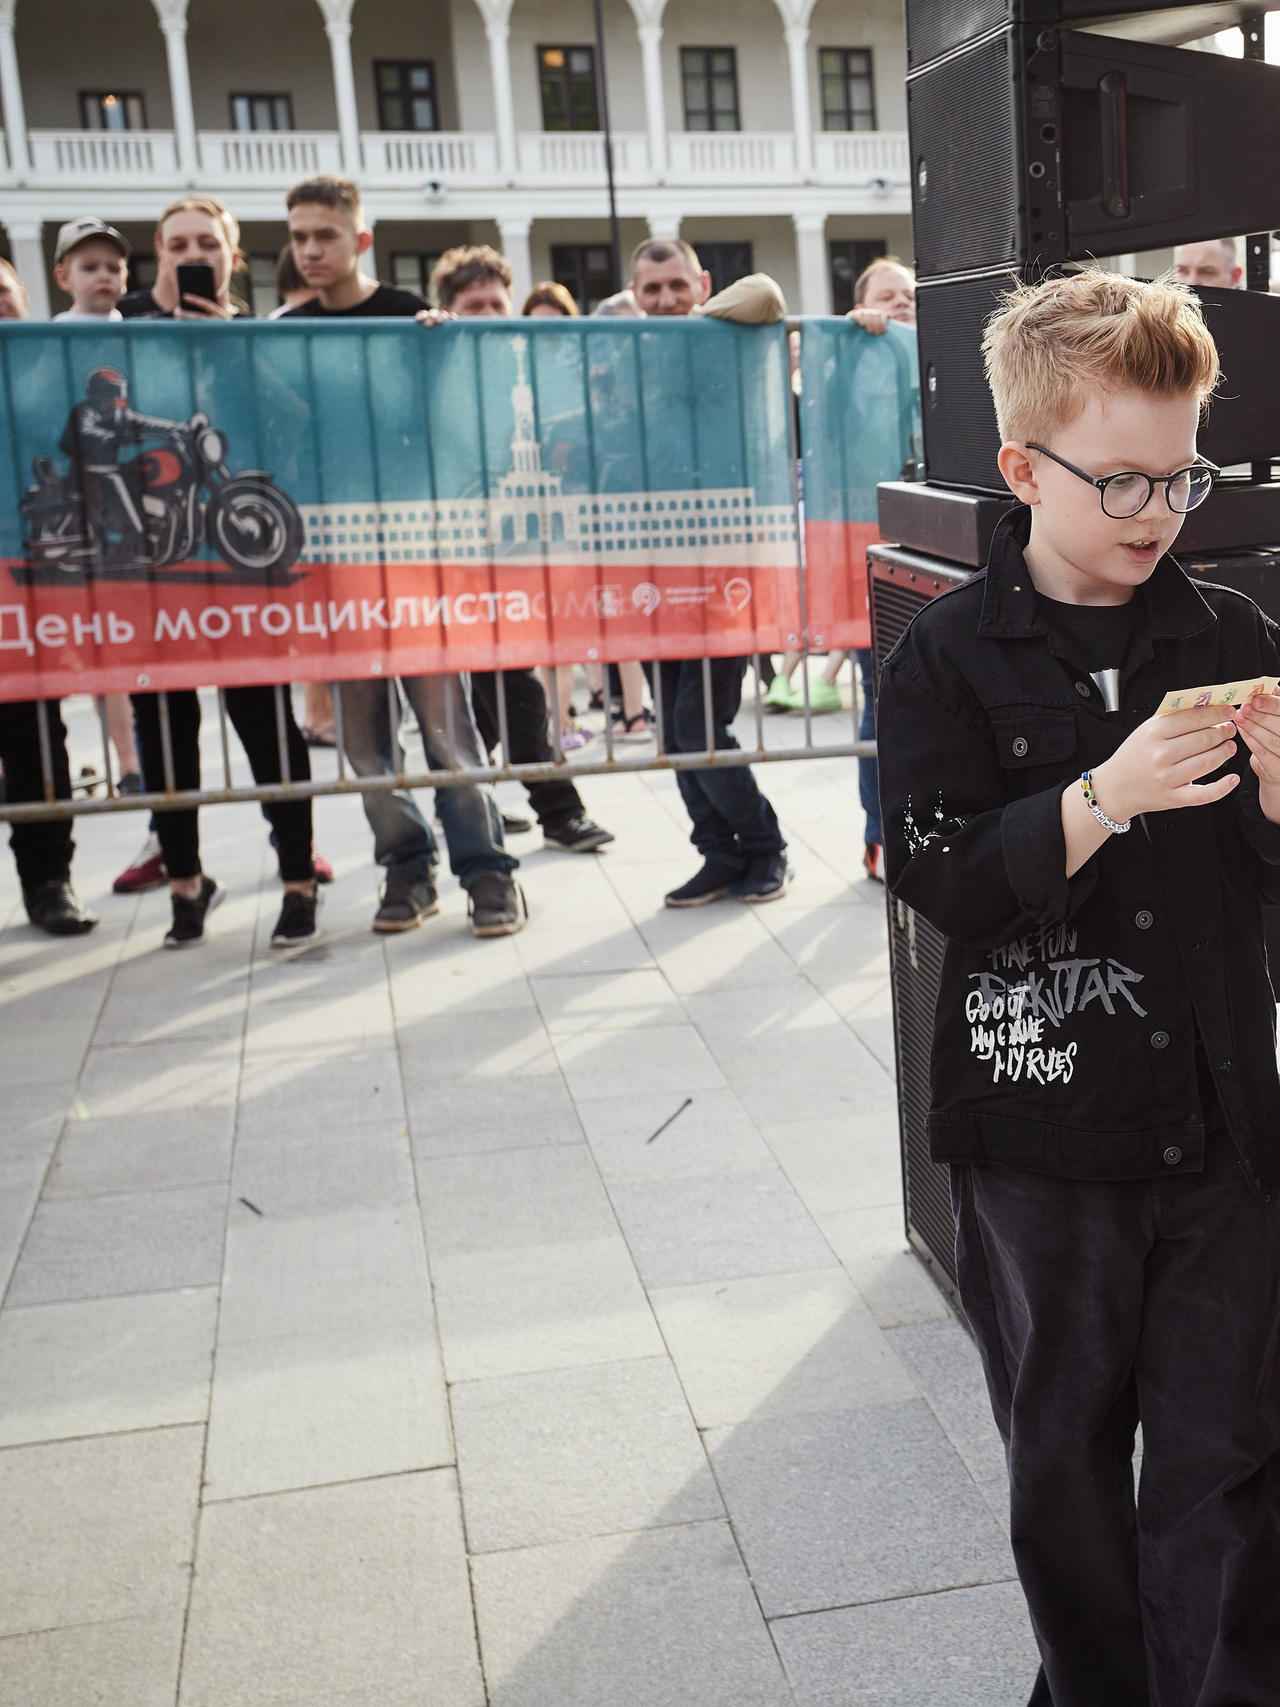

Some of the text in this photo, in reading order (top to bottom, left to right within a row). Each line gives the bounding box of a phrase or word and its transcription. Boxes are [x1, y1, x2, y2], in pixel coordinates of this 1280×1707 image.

[0, 590, 531, 657] День мотоциклиста
[1034, 921, 1077, 961] FUN
[1025, 1041, 1078, 1085] RULES
